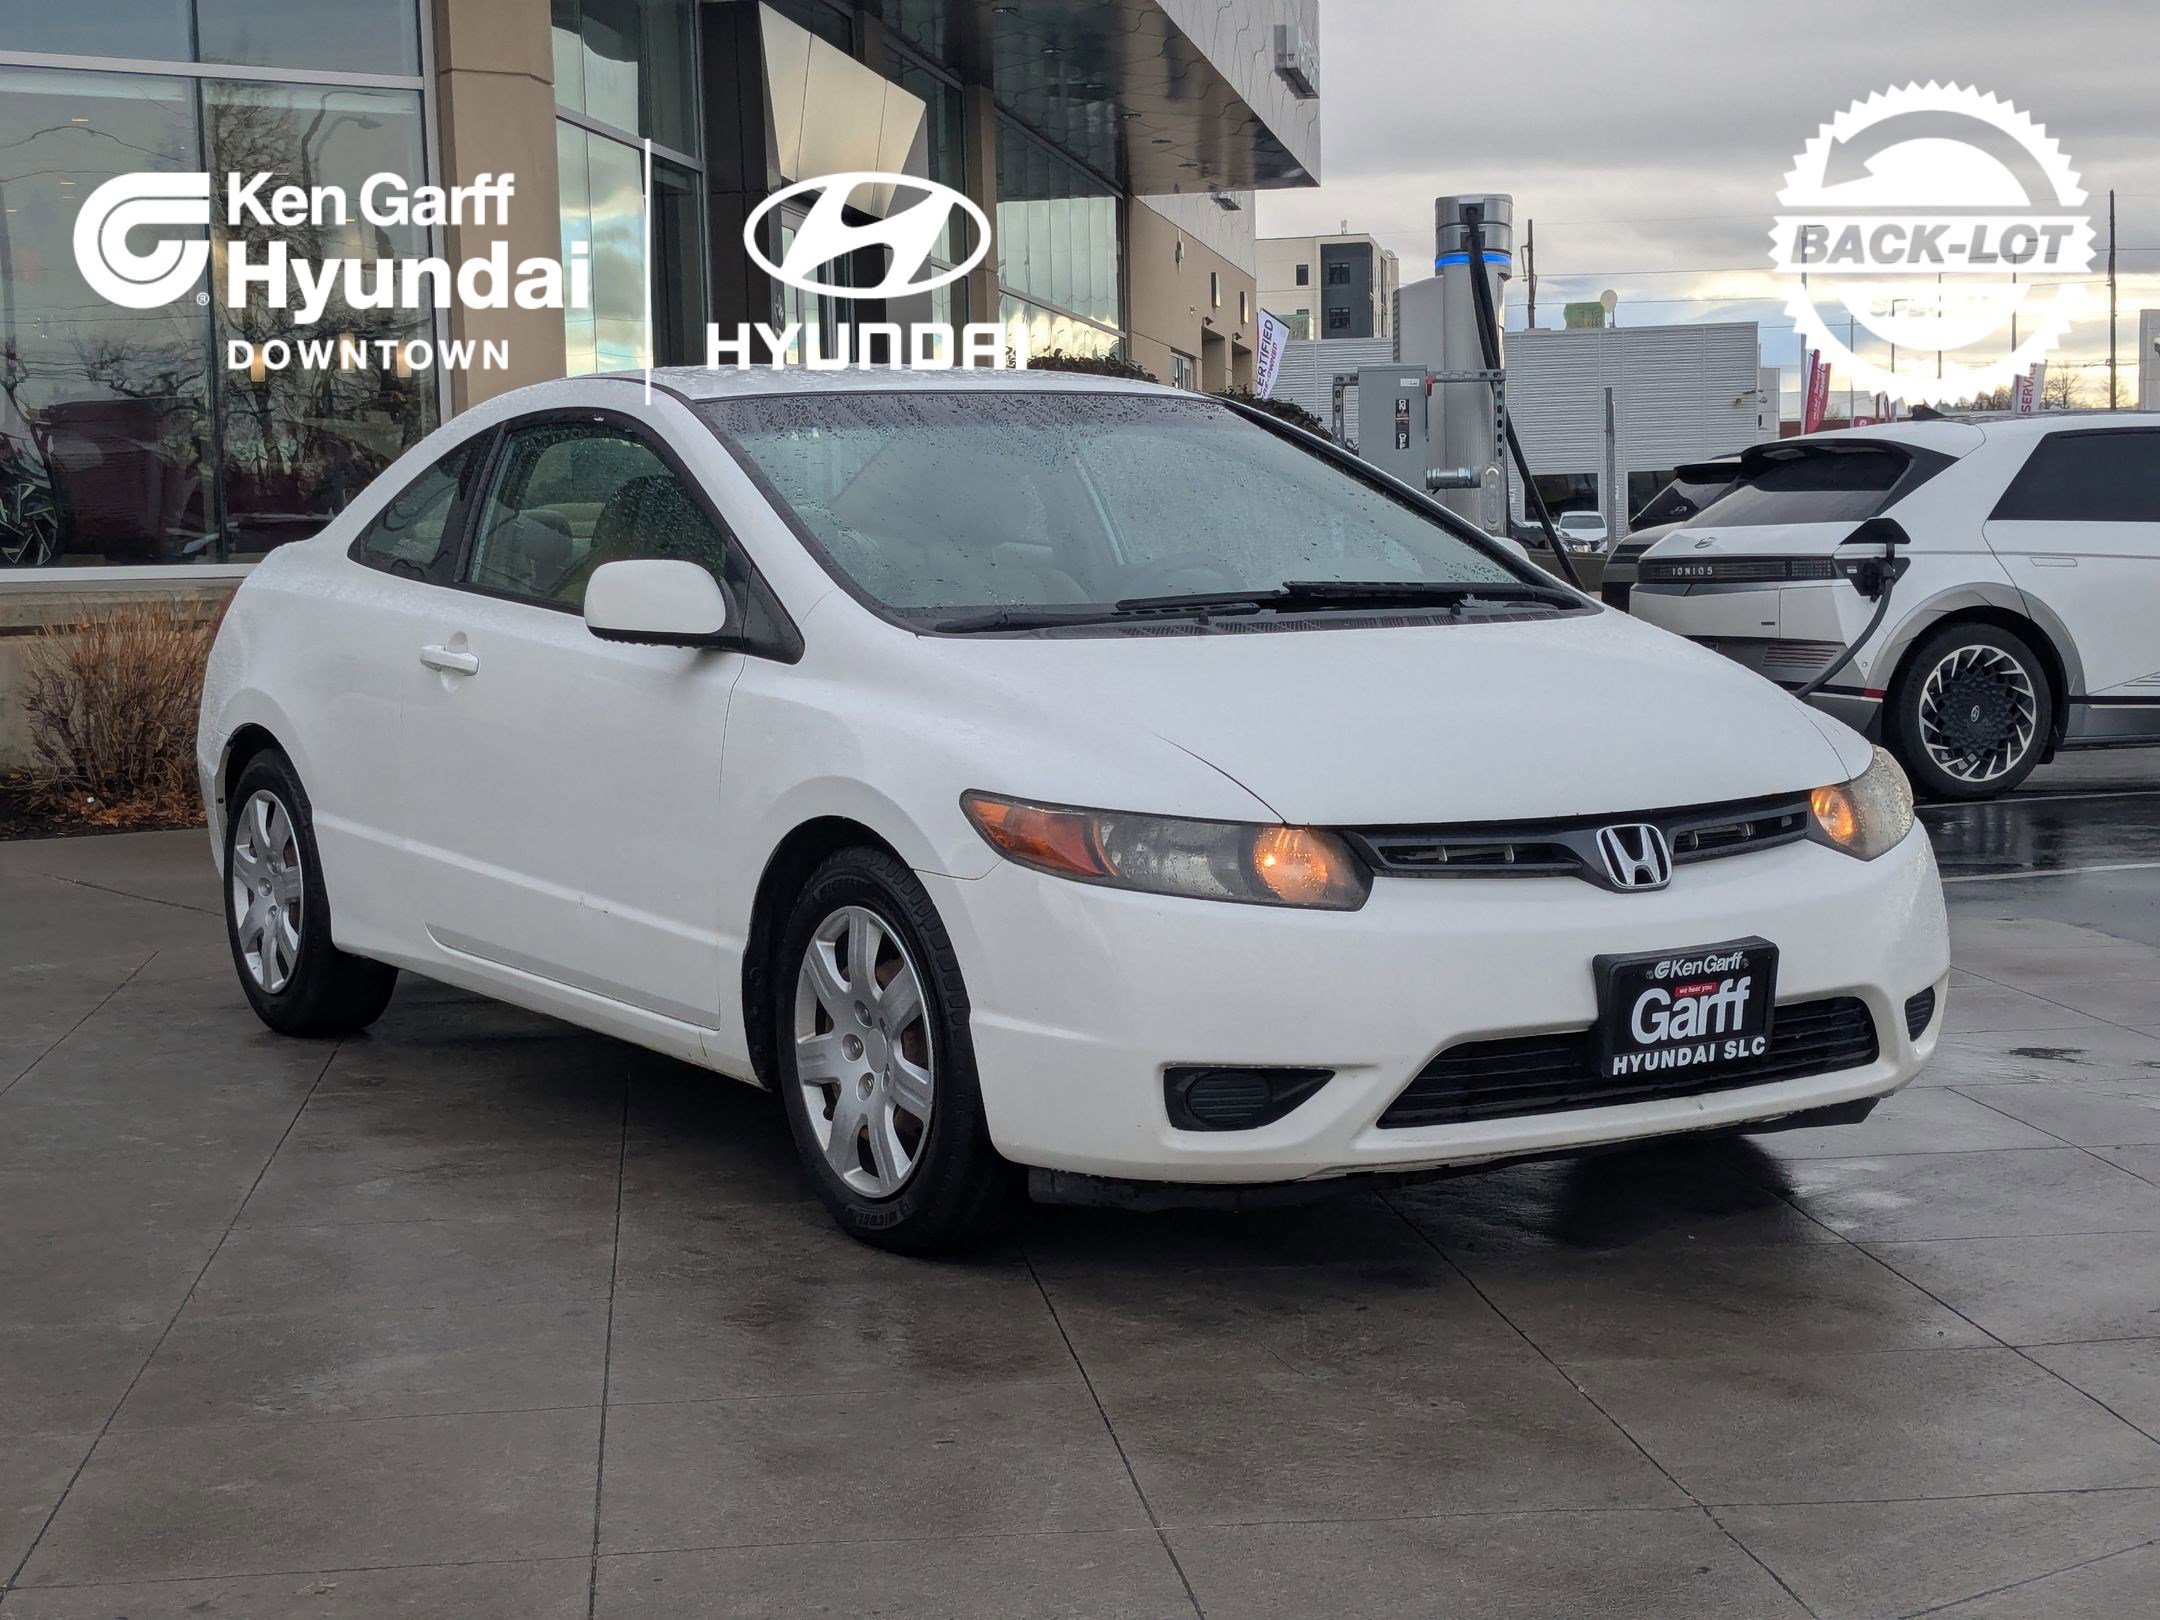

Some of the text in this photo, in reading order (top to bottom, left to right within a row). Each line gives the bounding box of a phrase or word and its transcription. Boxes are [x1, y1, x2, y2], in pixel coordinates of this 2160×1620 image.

[1670, 951, 1743, 979] Ken Garff
[1631, 976, 1751, 1045] Garff
[1612, 1036, 1766, 1076] HYUNDAI SLC
